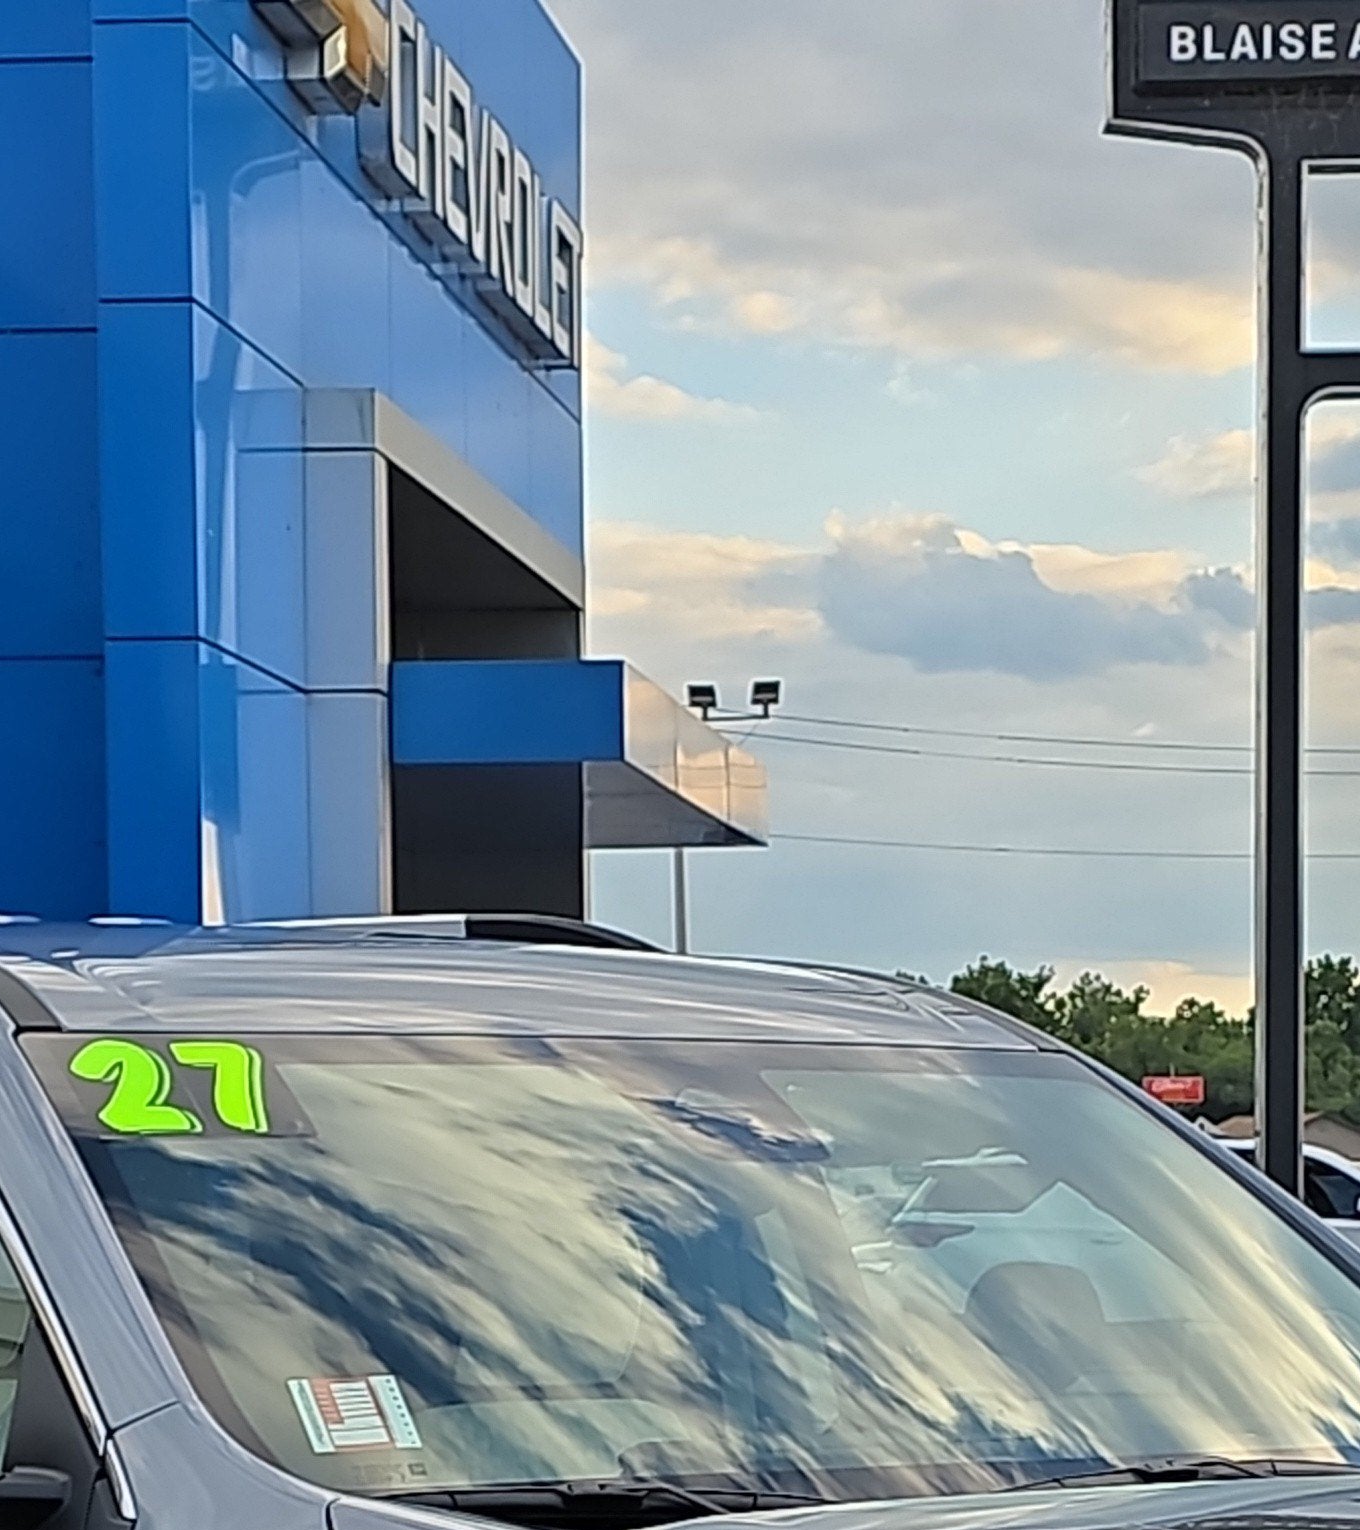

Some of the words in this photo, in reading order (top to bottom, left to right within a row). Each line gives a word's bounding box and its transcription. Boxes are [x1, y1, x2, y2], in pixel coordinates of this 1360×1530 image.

[1168, 21, 1338, 62] BLAISE
[389, 0, 583, 369] CHEVROLET
[69, 1038, 269, 1135] 27
